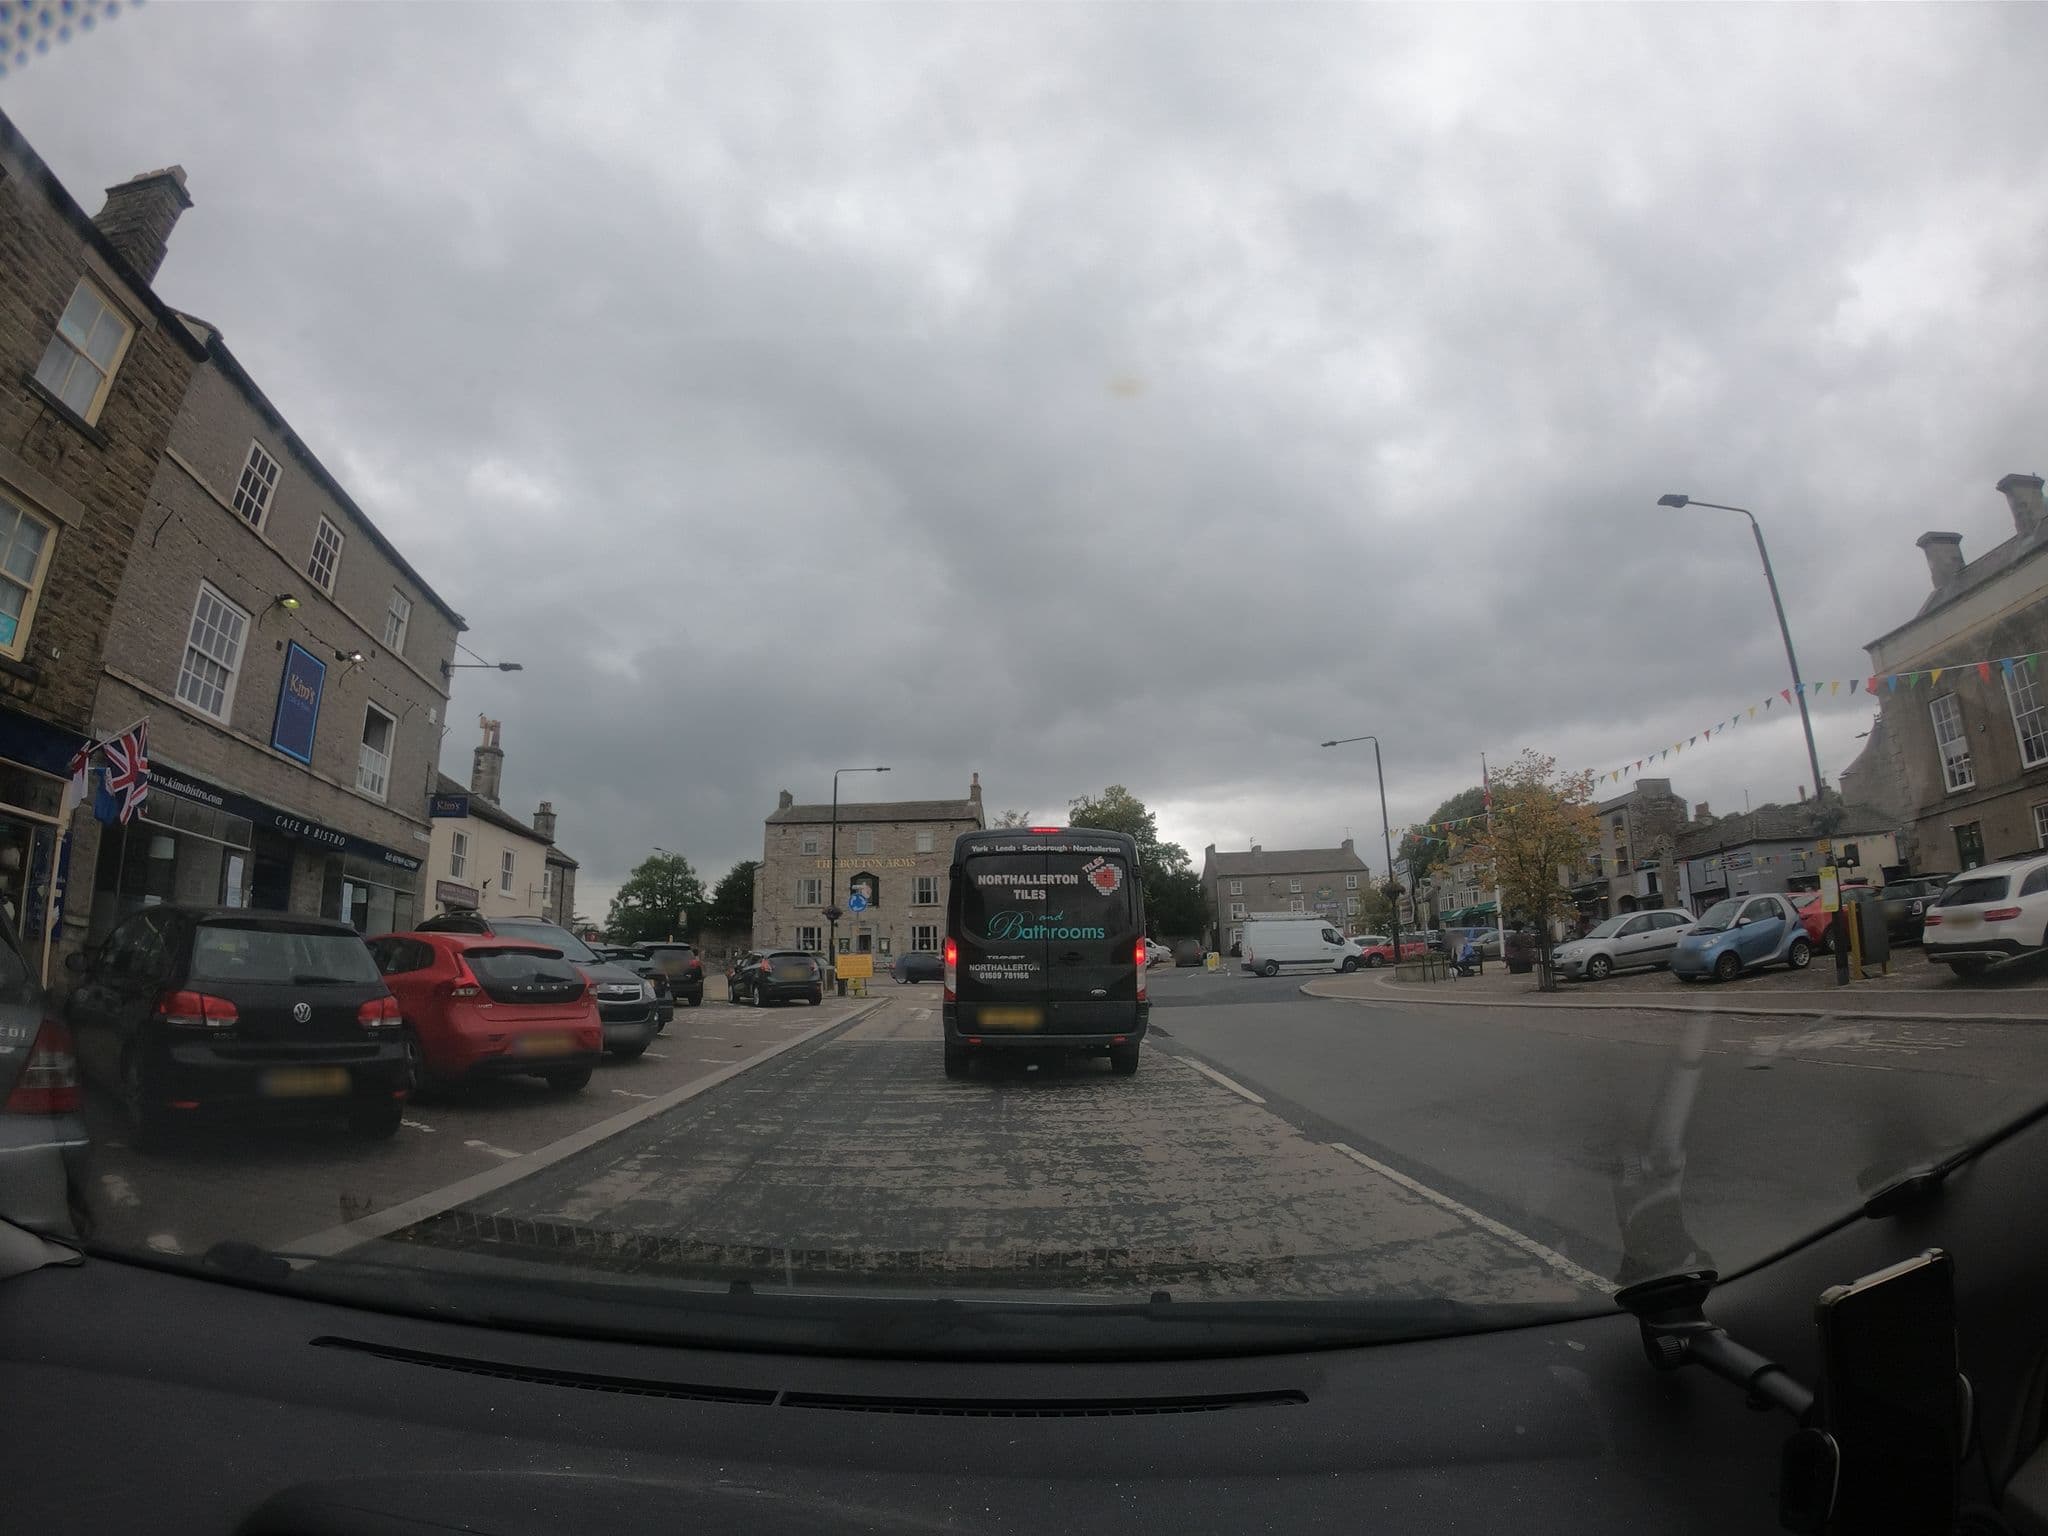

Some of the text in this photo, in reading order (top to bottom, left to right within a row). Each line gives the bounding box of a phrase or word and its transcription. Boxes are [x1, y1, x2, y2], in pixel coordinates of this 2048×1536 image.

[290, 674, 316, 704] Kim's
[303, 825, 310, 835] &
[313, 828, 346, 846] BISTRO
[1022, 844, 1067, 853] Scarborough
[1073, 845, 1121, 853] Northallerton
[840, 858, 883, 868] BOLTON
[885, 858, 916, 868] ARMS
[1082, 856, 1105, 873] TILES
[977, 874, 1079, 886] NORTHALLERTON
[1013, 889, 1046, 900] TILES
[1039, 910, 1064, 921] and
[987, 910, 1105, 941] Bathrooms
[969, 963, 1040, 971] NORTHALLERTON
